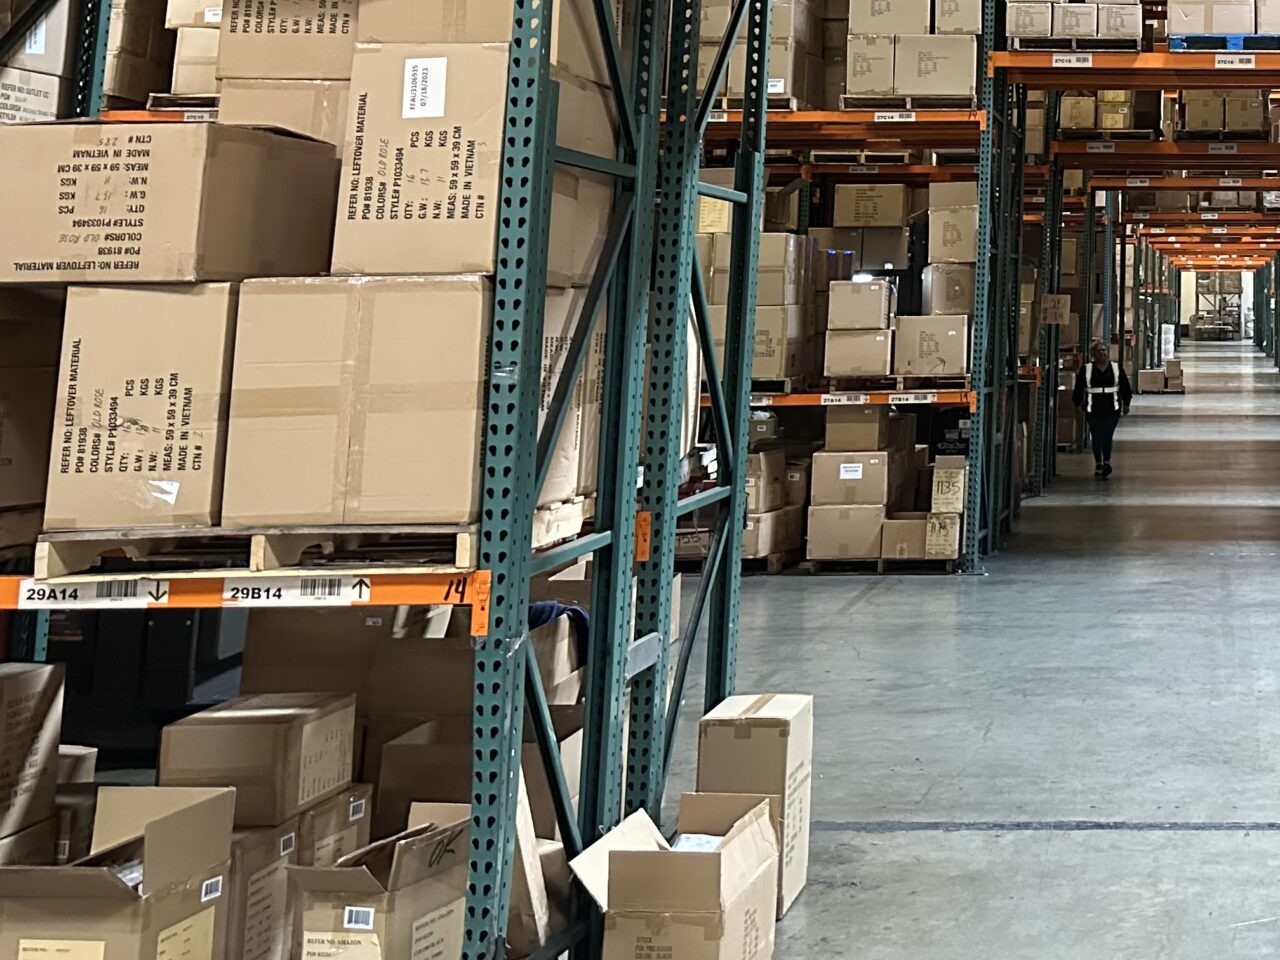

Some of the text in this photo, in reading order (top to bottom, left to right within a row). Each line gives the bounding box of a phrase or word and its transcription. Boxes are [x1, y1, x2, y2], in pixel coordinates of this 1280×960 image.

[424, 131, 433, 147] KGS
[439, 131, 447, 147] KGS
[454, 126, 462, 139] CM
[452, 140, 461, 151] 39
[73, 150, 108, 158] VIETNAM
[348, 92, 367, 220] REFER NO: LEFTOVER MATERIAL
[451, 160, 459, 170] 59
[404, 201, 413, 219] QTY:
[410, 132, 419, 147] PCS
[461, 140, 475, 218] MADE IN VIETNAM
[390, 148, 404, 220] STYLE# P1033494
[449, 180, 458, 190] 59
[362, 177, 373, 219] PO# 81938
[376, 182, 386, 219] COLORS#
[447, 193, 457, 219] MEAS:
[475, 201, 484, 218] CTN
[73, 219, 111, 227] P1033494
[98, 247, 122, 255] 81938
[13, 262, 53, 271] MATERIAL
[56, 262, 96, 270] LEFTOVER
[61, 338, 81, 473] REFER NO: LEFTOVER MATERIAL
[75, 428, 88, 473] PO# 81938
[90, 433, 101, 472] COLORS#
[105, 441, 115, 472] STYLE#
[26, 588, 78, 600] 29A14
[231, 587, 282, 600] 29B14
[444, 577, 467, 603] 14
